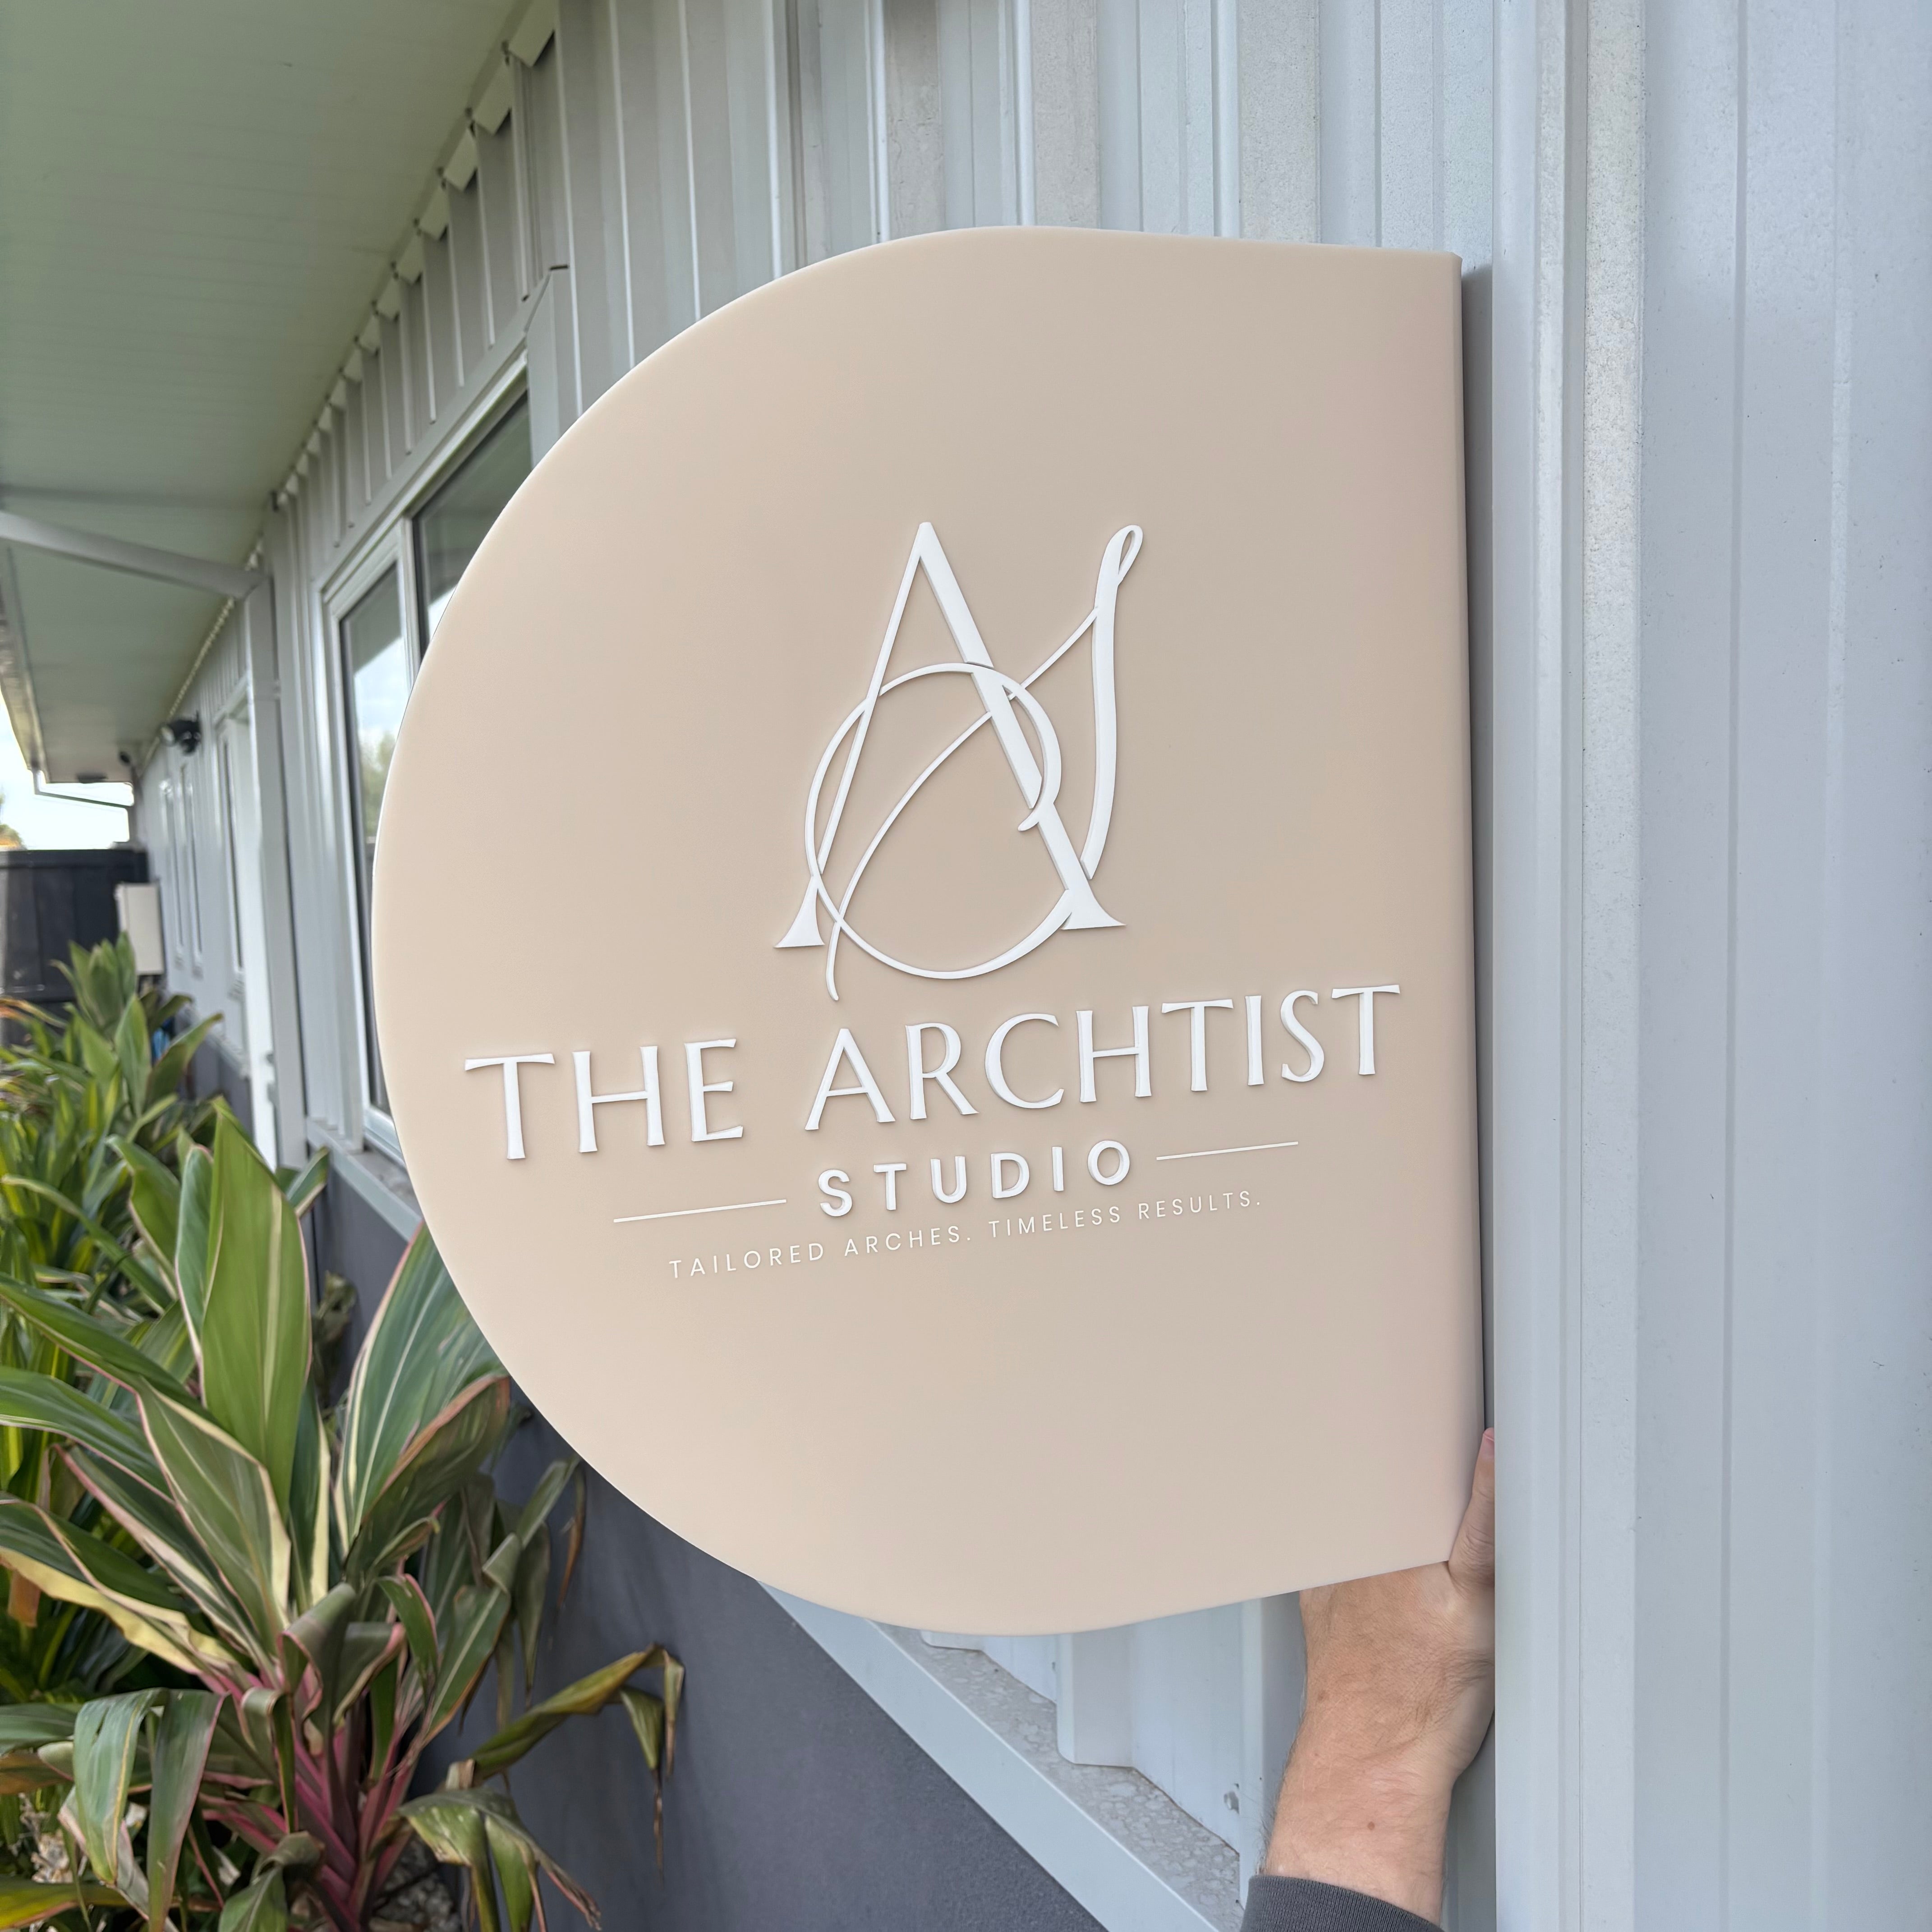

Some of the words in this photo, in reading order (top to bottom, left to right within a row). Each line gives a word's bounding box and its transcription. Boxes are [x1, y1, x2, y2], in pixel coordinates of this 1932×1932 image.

[464, 1038, 744, 1160] THE
[805, 984, 1400, 1130] ARCHTIST
[818, 1140, 1131, 1217] STUDIO
[669, 1242, 823, 1278] TAILORED
[844, 1225, 971, 1256] ARCHES.
[989, 1206, 1121, 1238] TIMELESS
[1138, 1190, 1260, 1219] RESULTS.
